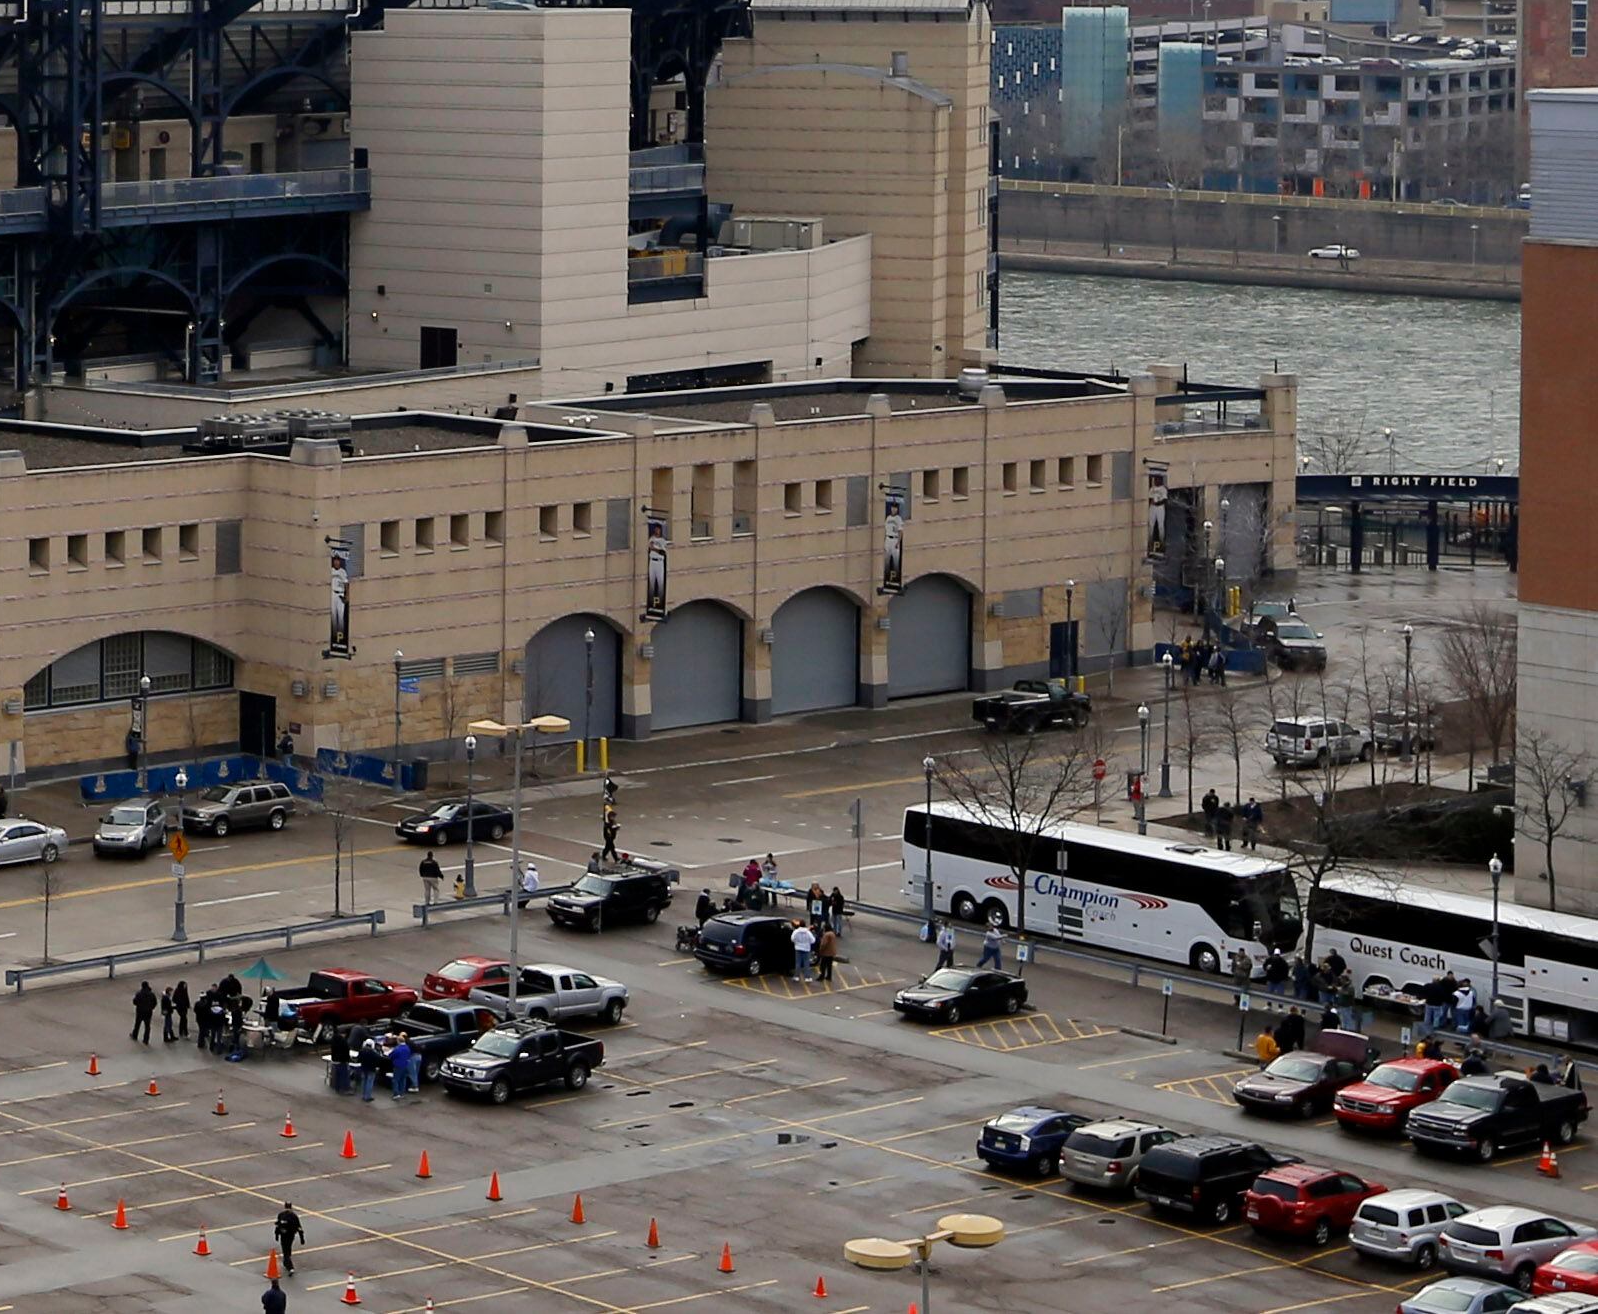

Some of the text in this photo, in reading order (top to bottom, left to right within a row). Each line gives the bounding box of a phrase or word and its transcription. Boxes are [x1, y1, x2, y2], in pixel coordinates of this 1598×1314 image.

[1373, 477, 1478, 487] RIGHT FIELD
[1034, 874, 1119, 908] Champion
[1350, 937, 1445, 970] Quest Coach
